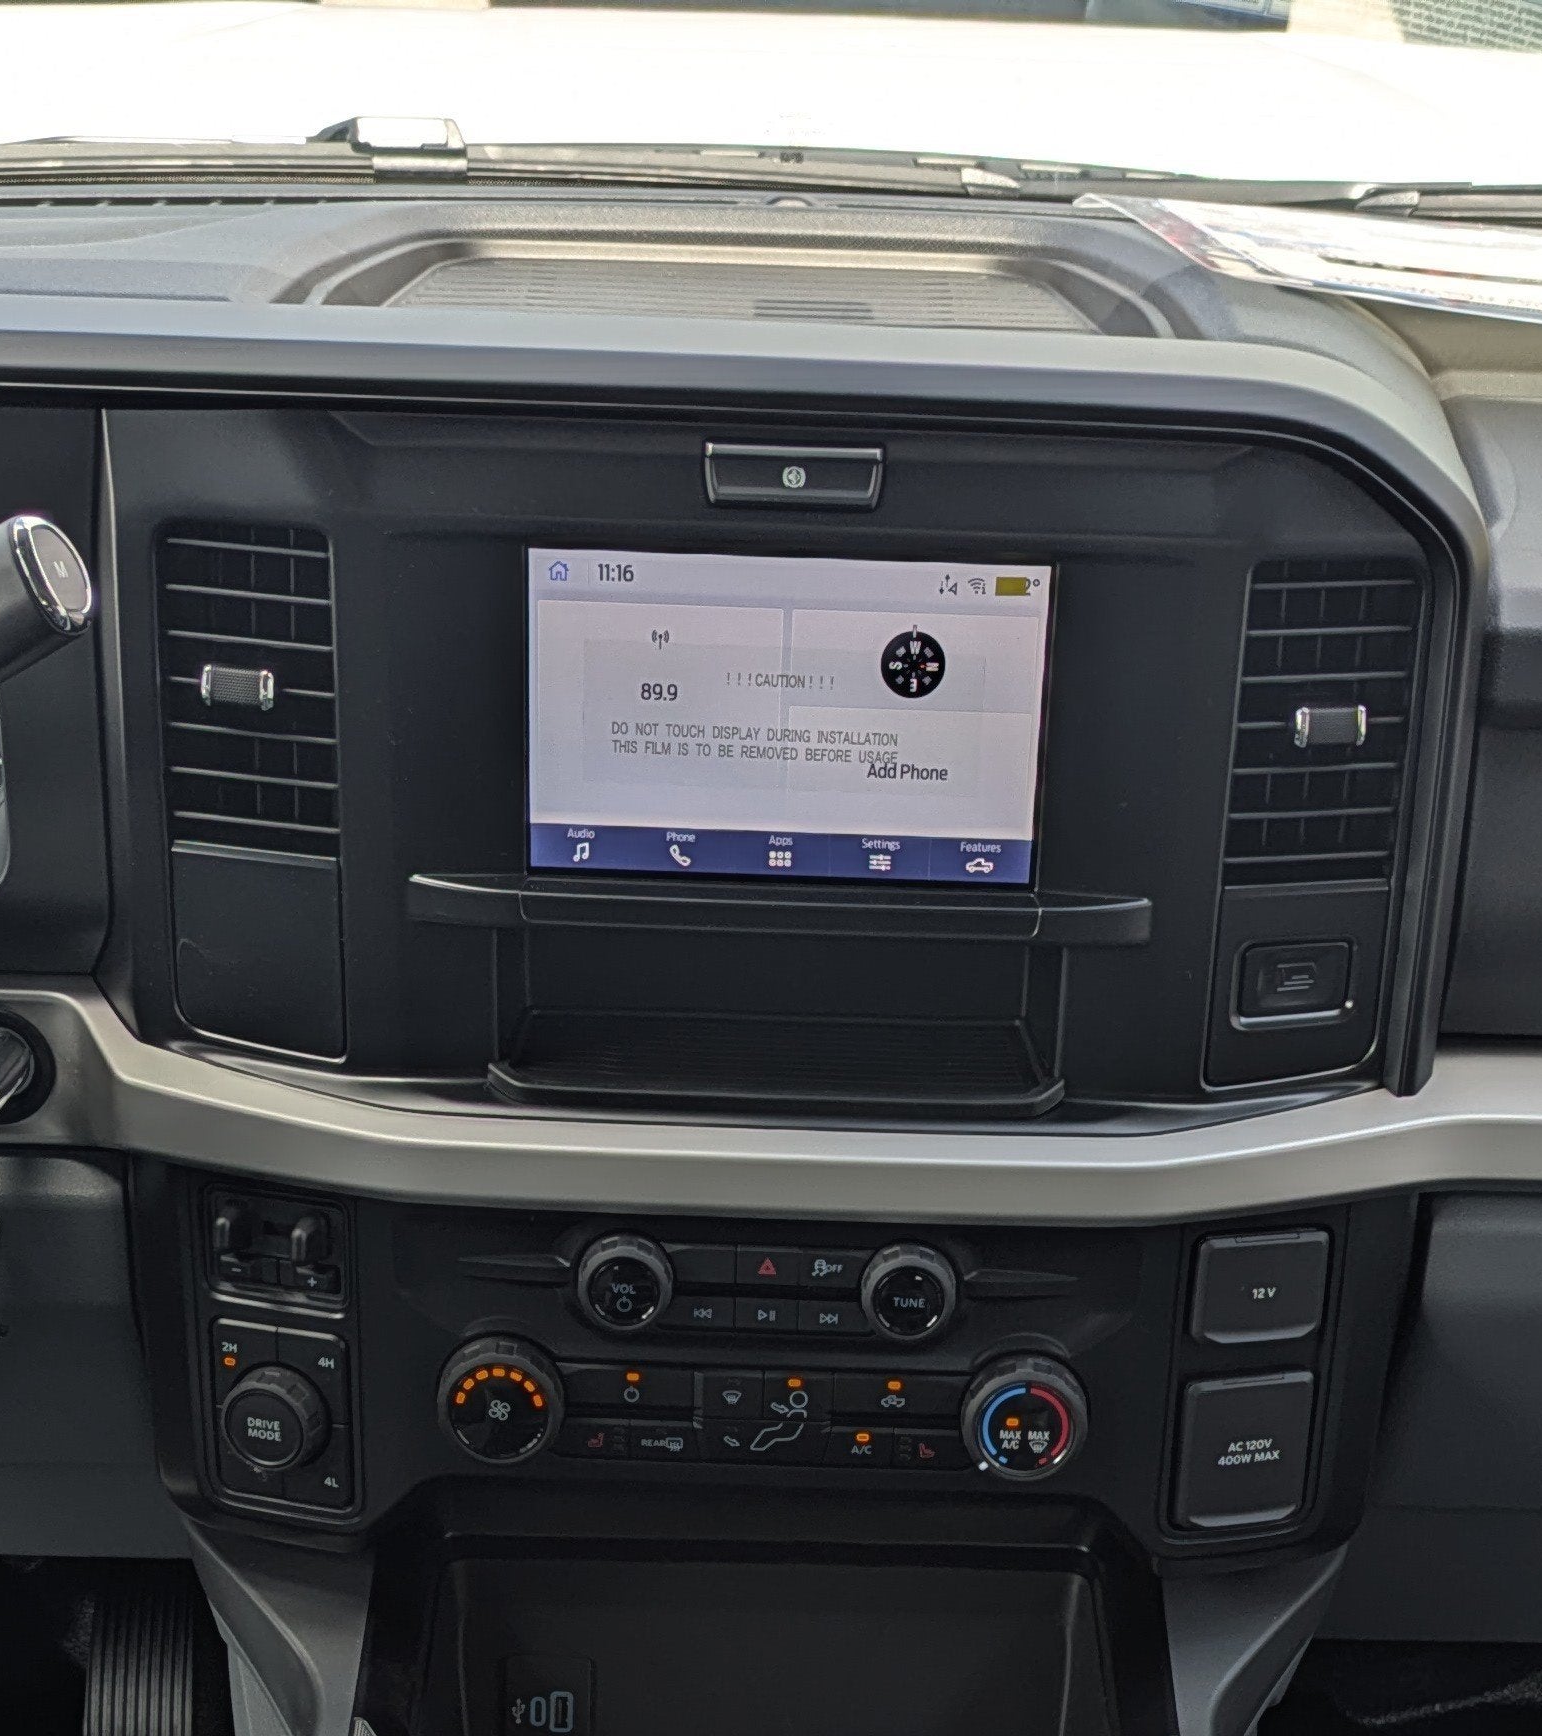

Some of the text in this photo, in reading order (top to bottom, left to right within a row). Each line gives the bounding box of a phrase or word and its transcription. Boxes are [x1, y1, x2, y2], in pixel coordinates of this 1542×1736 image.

[597, 563, 634, 582] 11:16
[641, 683, 678, 701] 89.9
[611, 721, 898, 746] DO NOT TOUCH DISPLAY DURING INSTALLATION
[612, 739, 898, 764] THIS FILM IS TO BE REMOVED BEFORE USAGE
[867, 762, 949, 781] Add Phone
[567, 828, 595, 839] Audio
[666, 831, 695, 843] Phone
[768, 835, 793, 847] Apps
[862, 837, 901, 852] Settings
[960, 841, 1002, 854] Features
[826, 1263, 843, 1274] OFF
[611, 1283, 637, 1295] VOL
[893, 1296, 926, 1309] TUNE
[221, 1341, 238, 1353] 2H
[317, 1357, 335, 1369] 4H
[246, 1417, 280, 1431] DRIVE
[247, 1428, 282, 1442] MODE
[1000, 1430, 1021, 1441] MAX
[1028, 1430, 1050, 1441] MAX
[641, 1438, 667, 1448] REAR
[1001, 1439, 1020, 1451] A/C
[1228, 1438, 1273, 1453] AC 120V
[851, 1445, 872, 1455] A/C
[1217, 1450, 1281, 1467] 400W MAX
[324, 1477, 339, 1488] 4L
